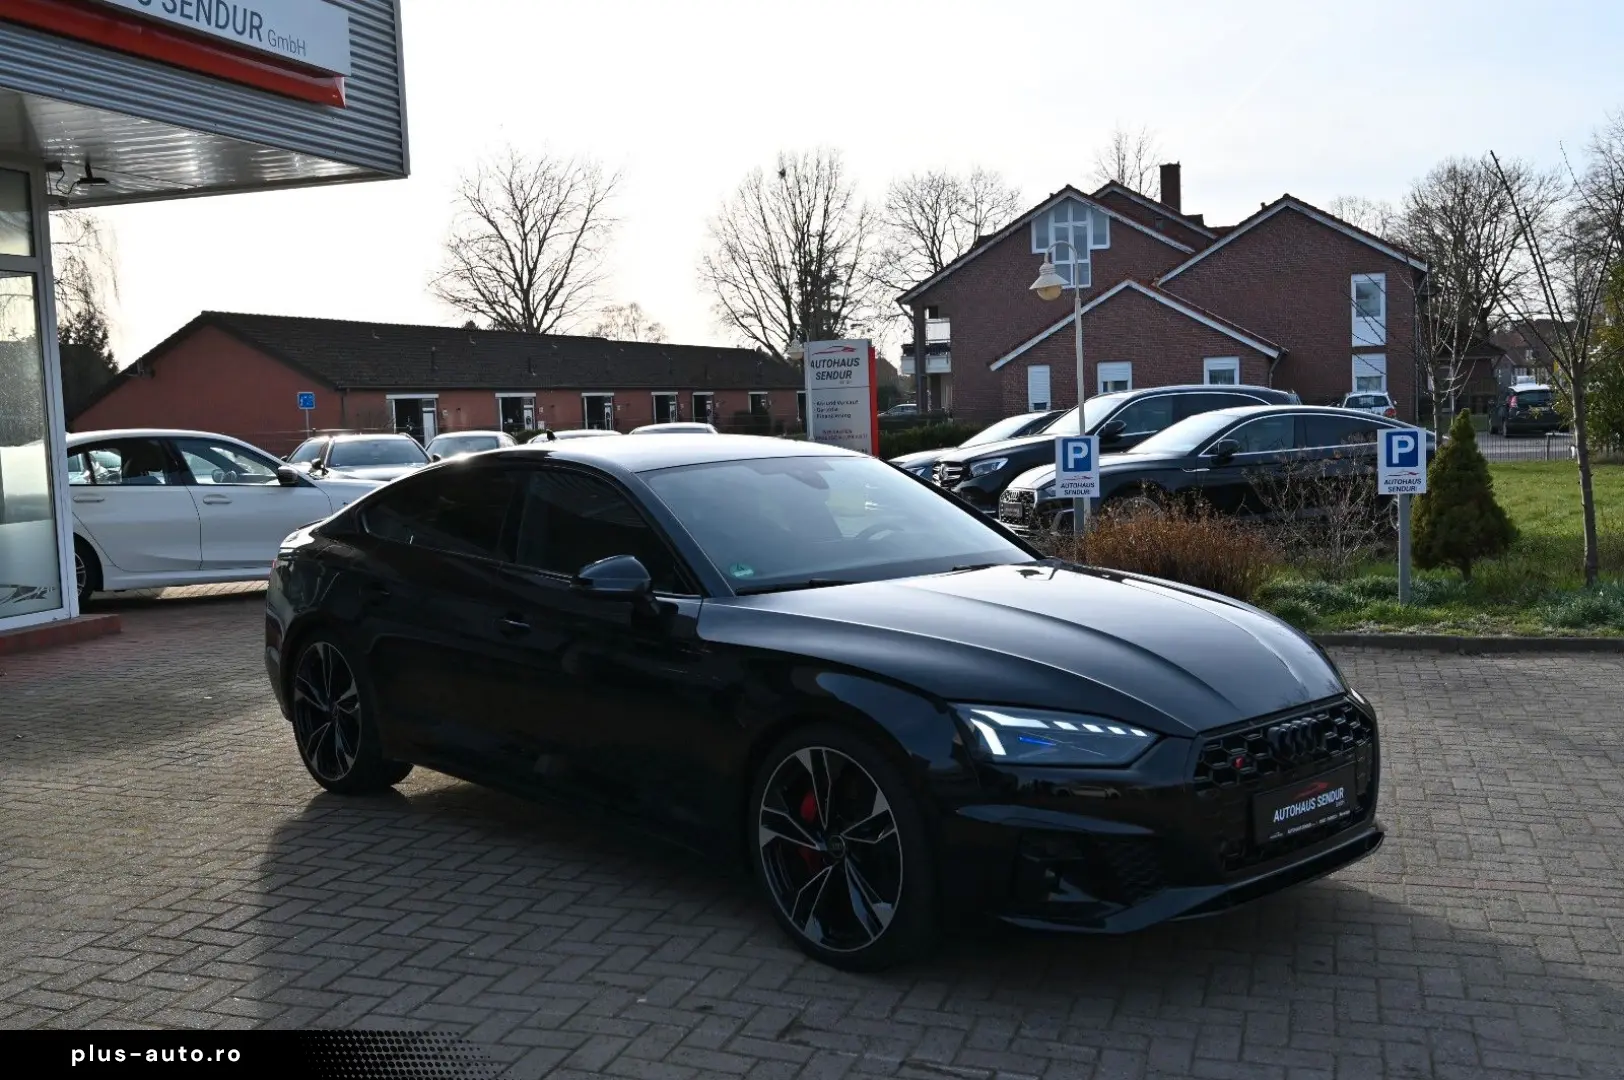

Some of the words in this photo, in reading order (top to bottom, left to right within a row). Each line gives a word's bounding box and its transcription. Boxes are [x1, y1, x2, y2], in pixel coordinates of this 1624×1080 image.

[268, 29, 306, 56] GmbH
[811, 357, 860, 369] AUTOHAUS
[815, 370, 852, 380] SENDUR
[1068, 441, 1089, 469] P
[1392, 435, 1415, 464] P
[1387, 485, 1416, 493] SENDUR
[1273, 797, 1316, 823] AUTOHAUS
[1317, 787, 1344, 808] SENDUR
